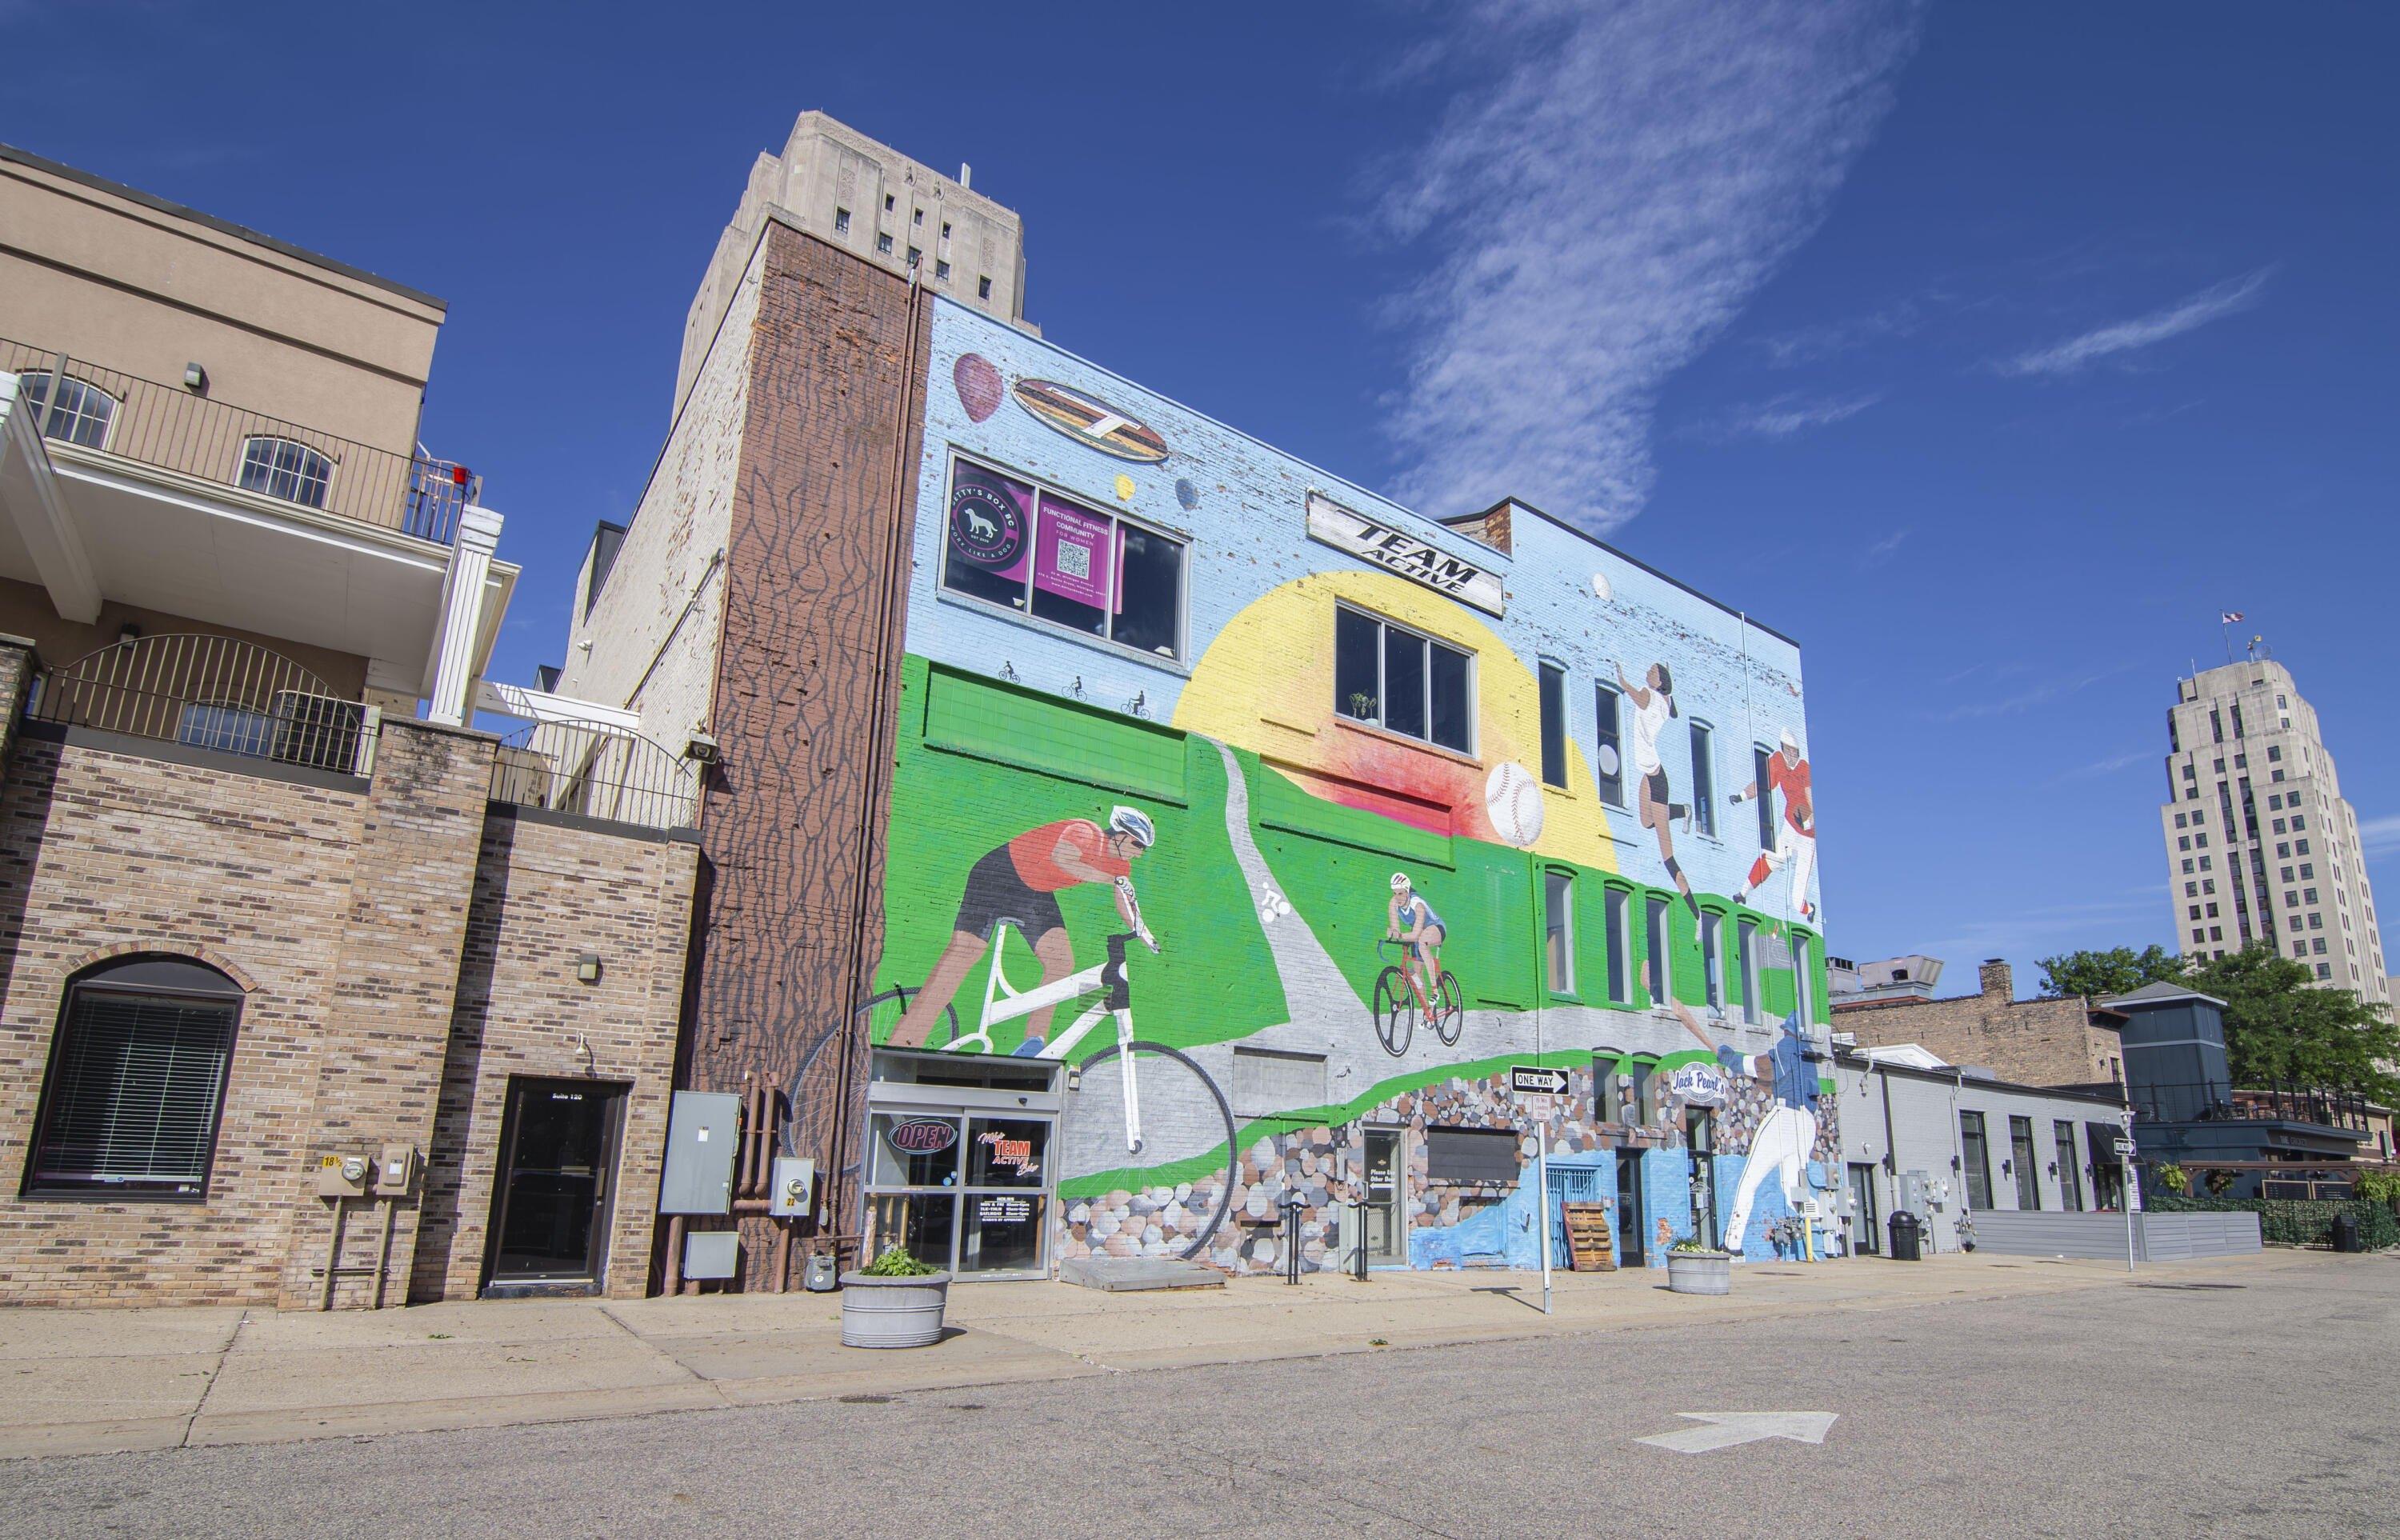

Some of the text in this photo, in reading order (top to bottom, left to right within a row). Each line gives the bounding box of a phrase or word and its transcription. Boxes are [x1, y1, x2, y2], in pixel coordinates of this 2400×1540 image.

[986, 493, 1006, 510] BOX
[1005, 514, 1014, 526] BC
[1043, 506, 1108, 536] FUNCTIONAL FITNESS
[1056, 521, 1095, 539] COMMUNITY
[1070, 536, 1094, 546] WOMEN
[1334, 509, 1479, 584] TEAM
[969, 548, 986, 558] LIKE
[1360, 549, 1465, 594] ACTIVE
[1518, 1074, 1553, 1086] ONE WAY
[1673, 1071, 1724, 1095] Jack Pearl's
[897, 1124, 950, 1148] OPEN
[994, 1140, 1031, 1156] TEAM
[325, 1157, 334, 1166] 18
[992, 1156, 1029, 1164] ACTIVE
